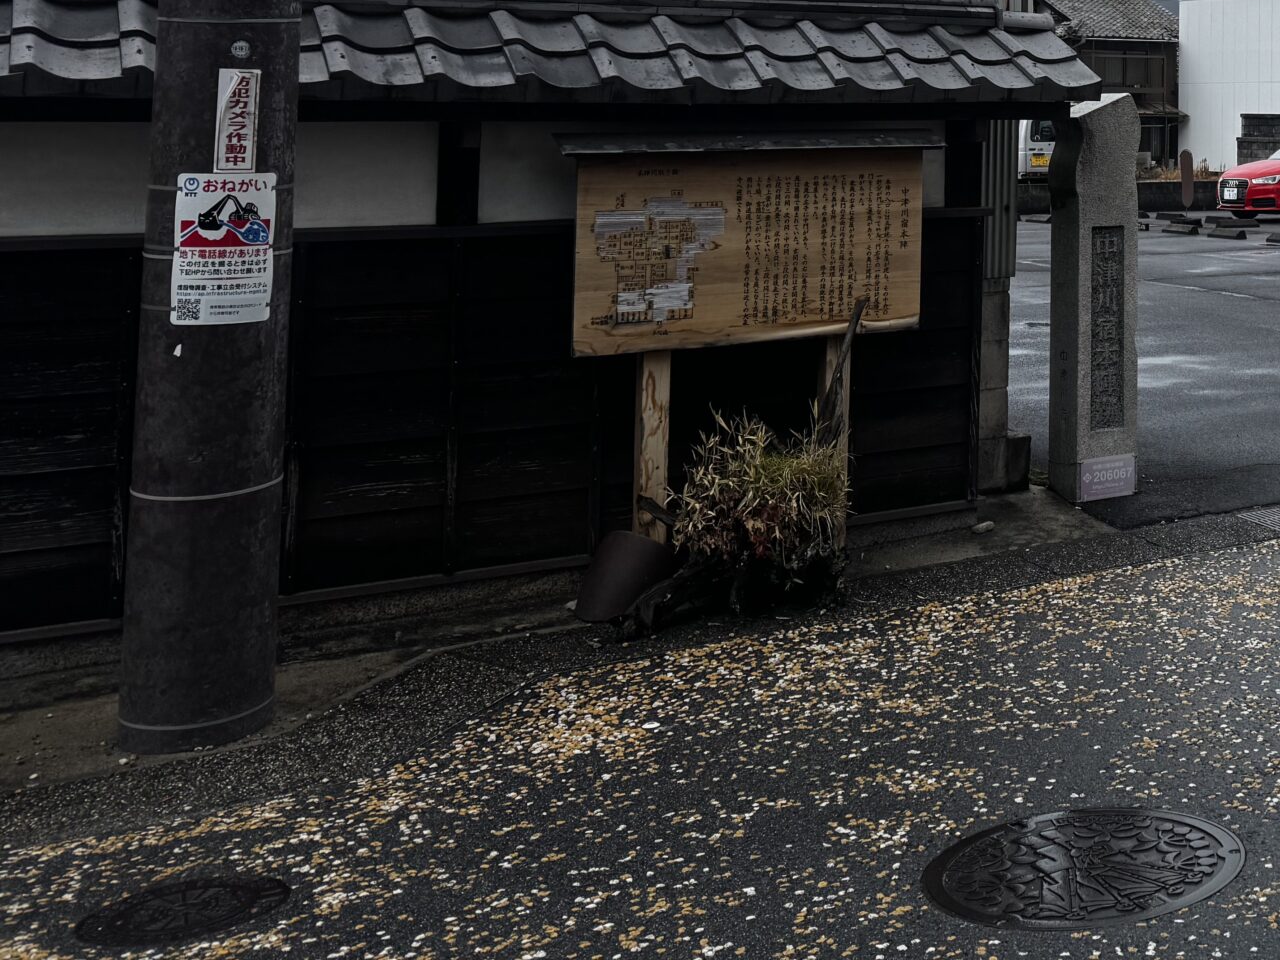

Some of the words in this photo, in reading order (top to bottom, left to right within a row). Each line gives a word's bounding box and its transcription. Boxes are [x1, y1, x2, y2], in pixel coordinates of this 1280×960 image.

[203, 178, 268, 193] おねがい
[899, 185, 911, 249] 中津川宿本陣
[179, 248, 268, 259] 地下電話線があります
[179, 259, 268, 268] この付近を掘るときは必ず
[179, 267, 267, 276] 下記HPから問い合わせ願います
[1093, 467, 1132, 482] 206067
